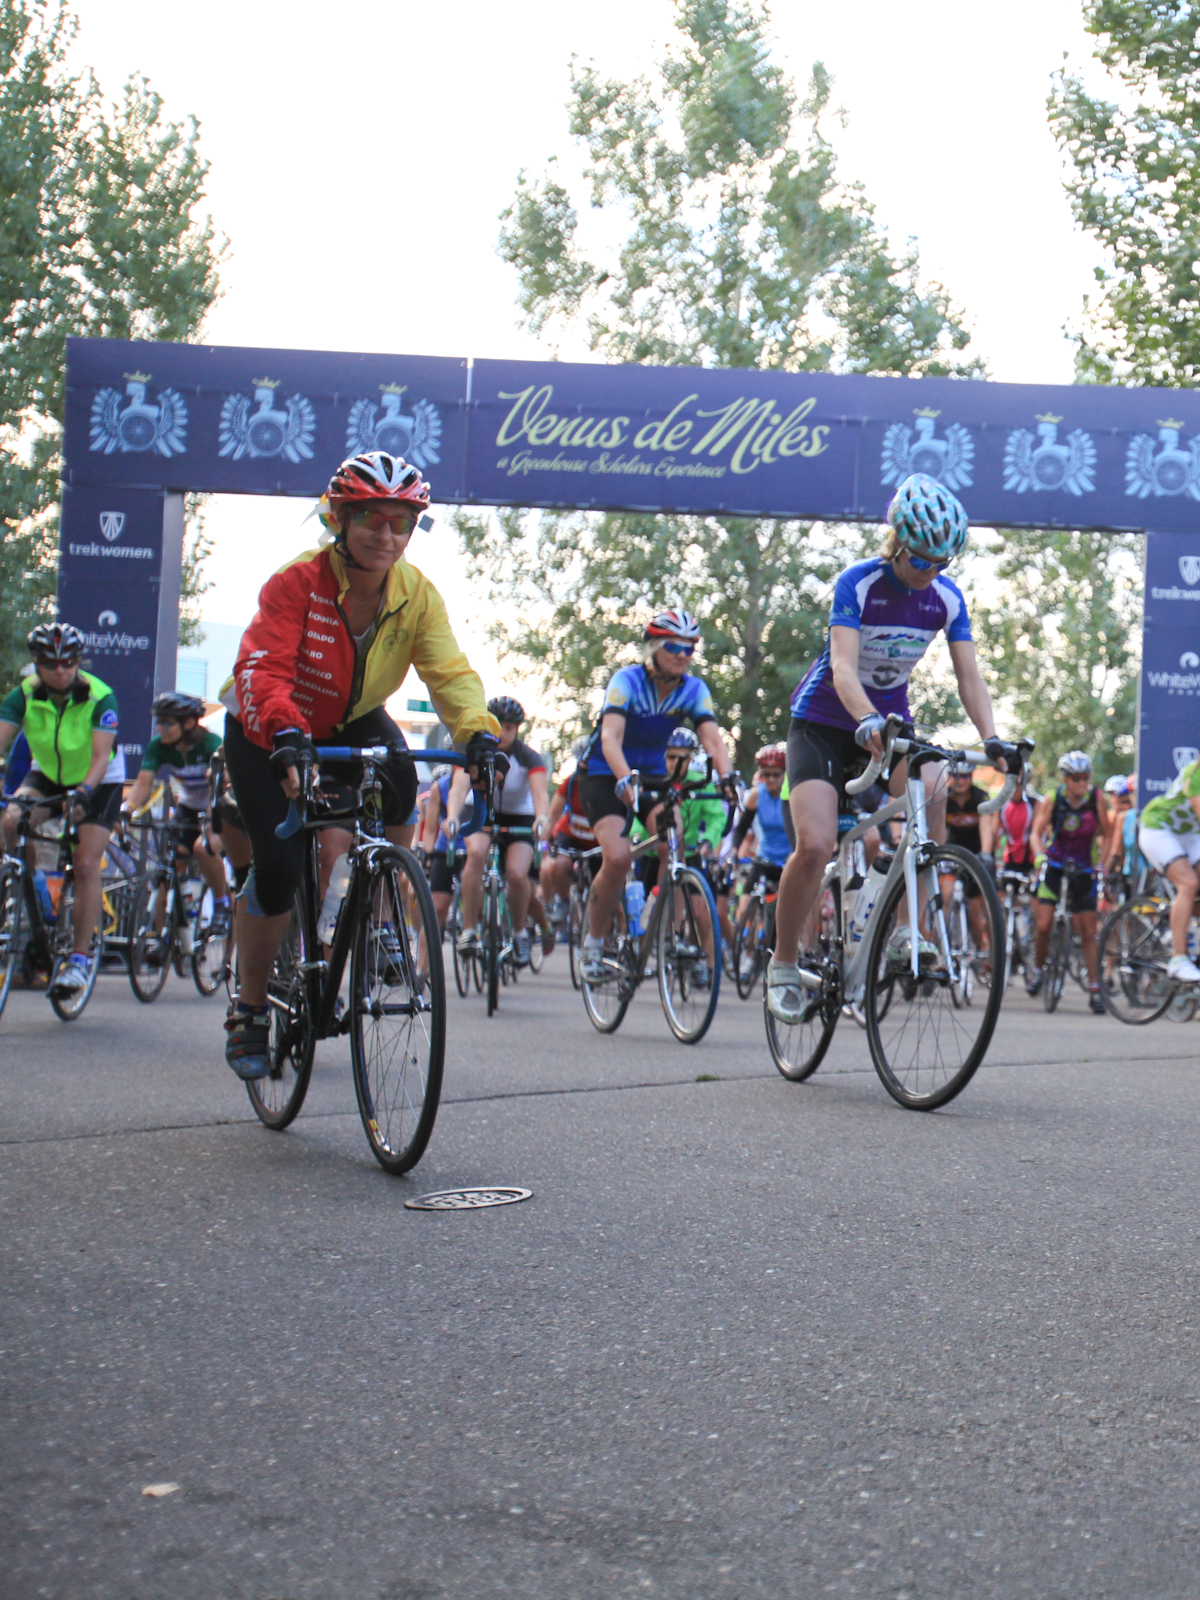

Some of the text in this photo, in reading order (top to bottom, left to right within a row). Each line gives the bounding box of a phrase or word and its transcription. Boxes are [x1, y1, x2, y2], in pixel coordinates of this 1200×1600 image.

[496, 385, 830, 475] Venus de Miles
[496, 449, 727, 479] a Greenhouse Scholars Experience
